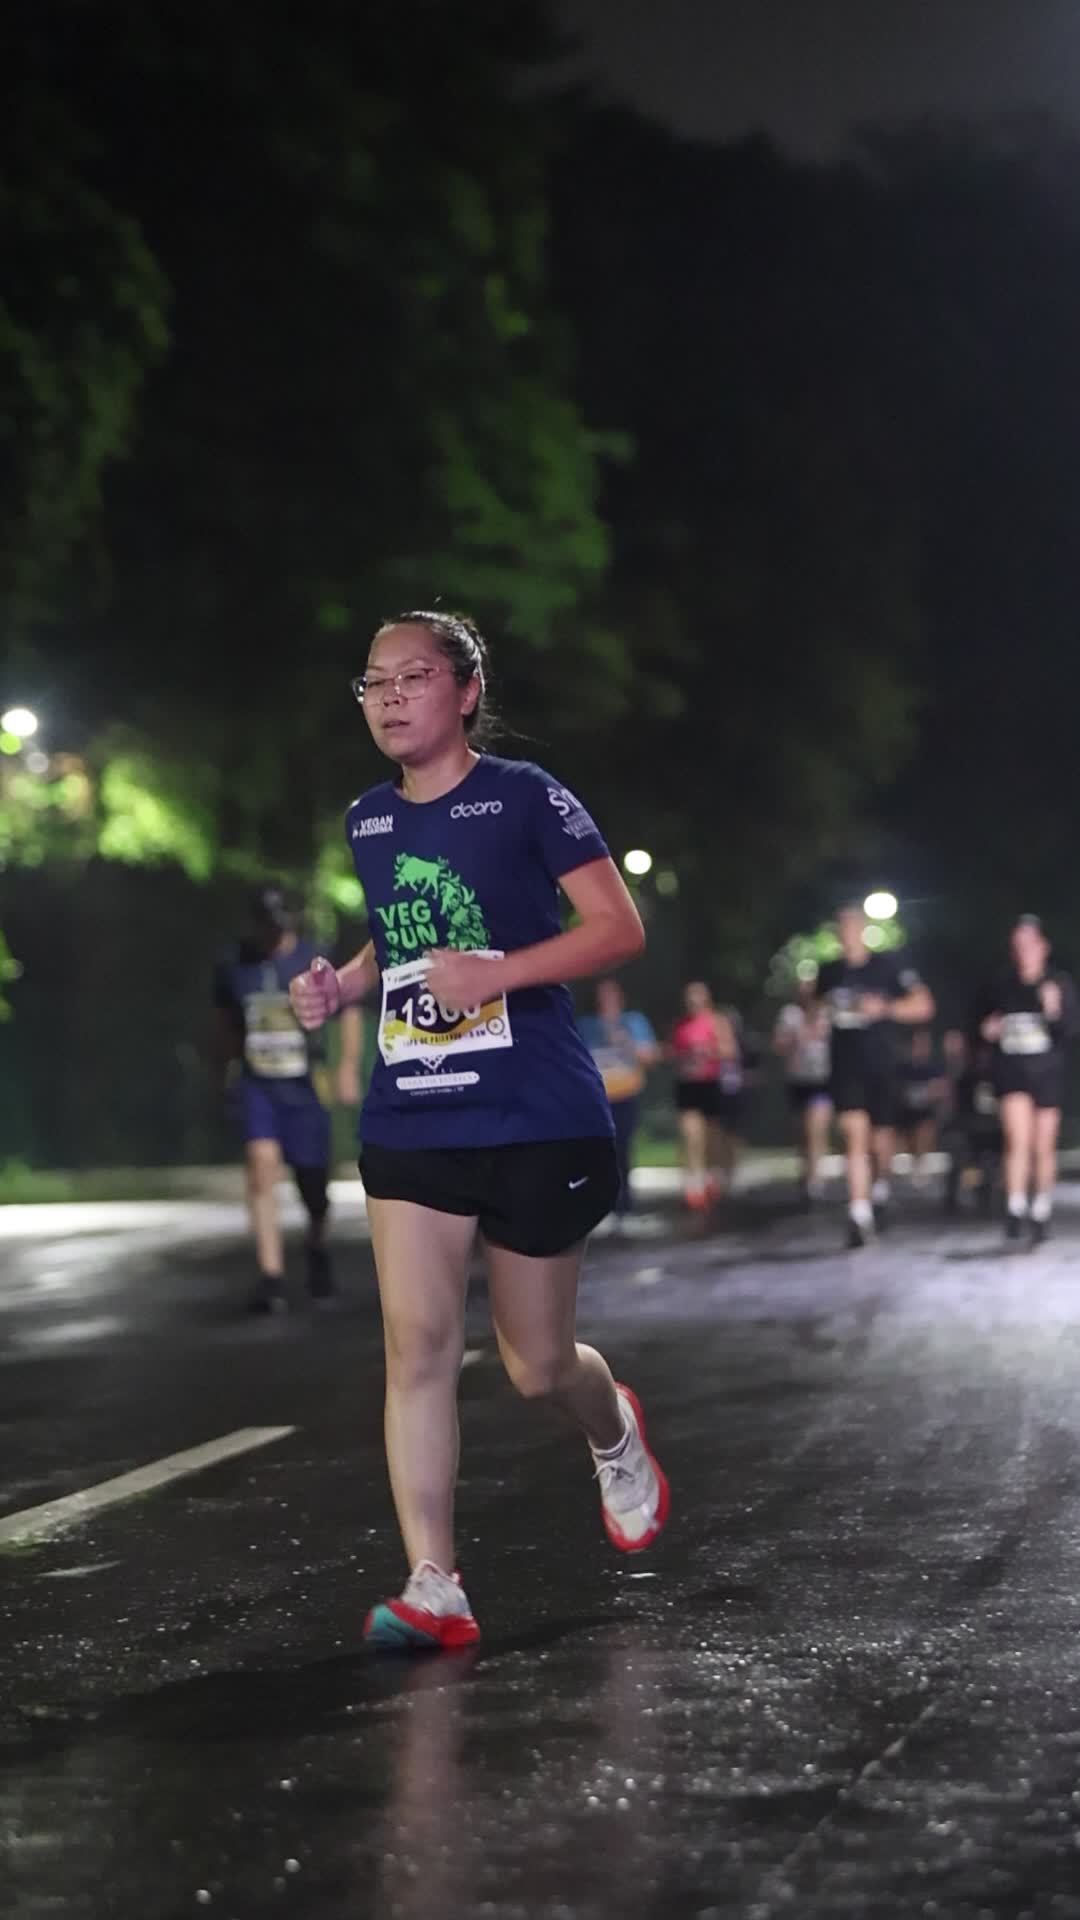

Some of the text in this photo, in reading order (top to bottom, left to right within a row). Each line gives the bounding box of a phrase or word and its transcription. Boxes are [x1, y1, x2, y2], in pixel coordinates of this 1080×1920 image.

[360, 813, 394, 829] VEGAN
[374, 899, 432, 929] VEG
[385, 923, 438, 950] RUN
